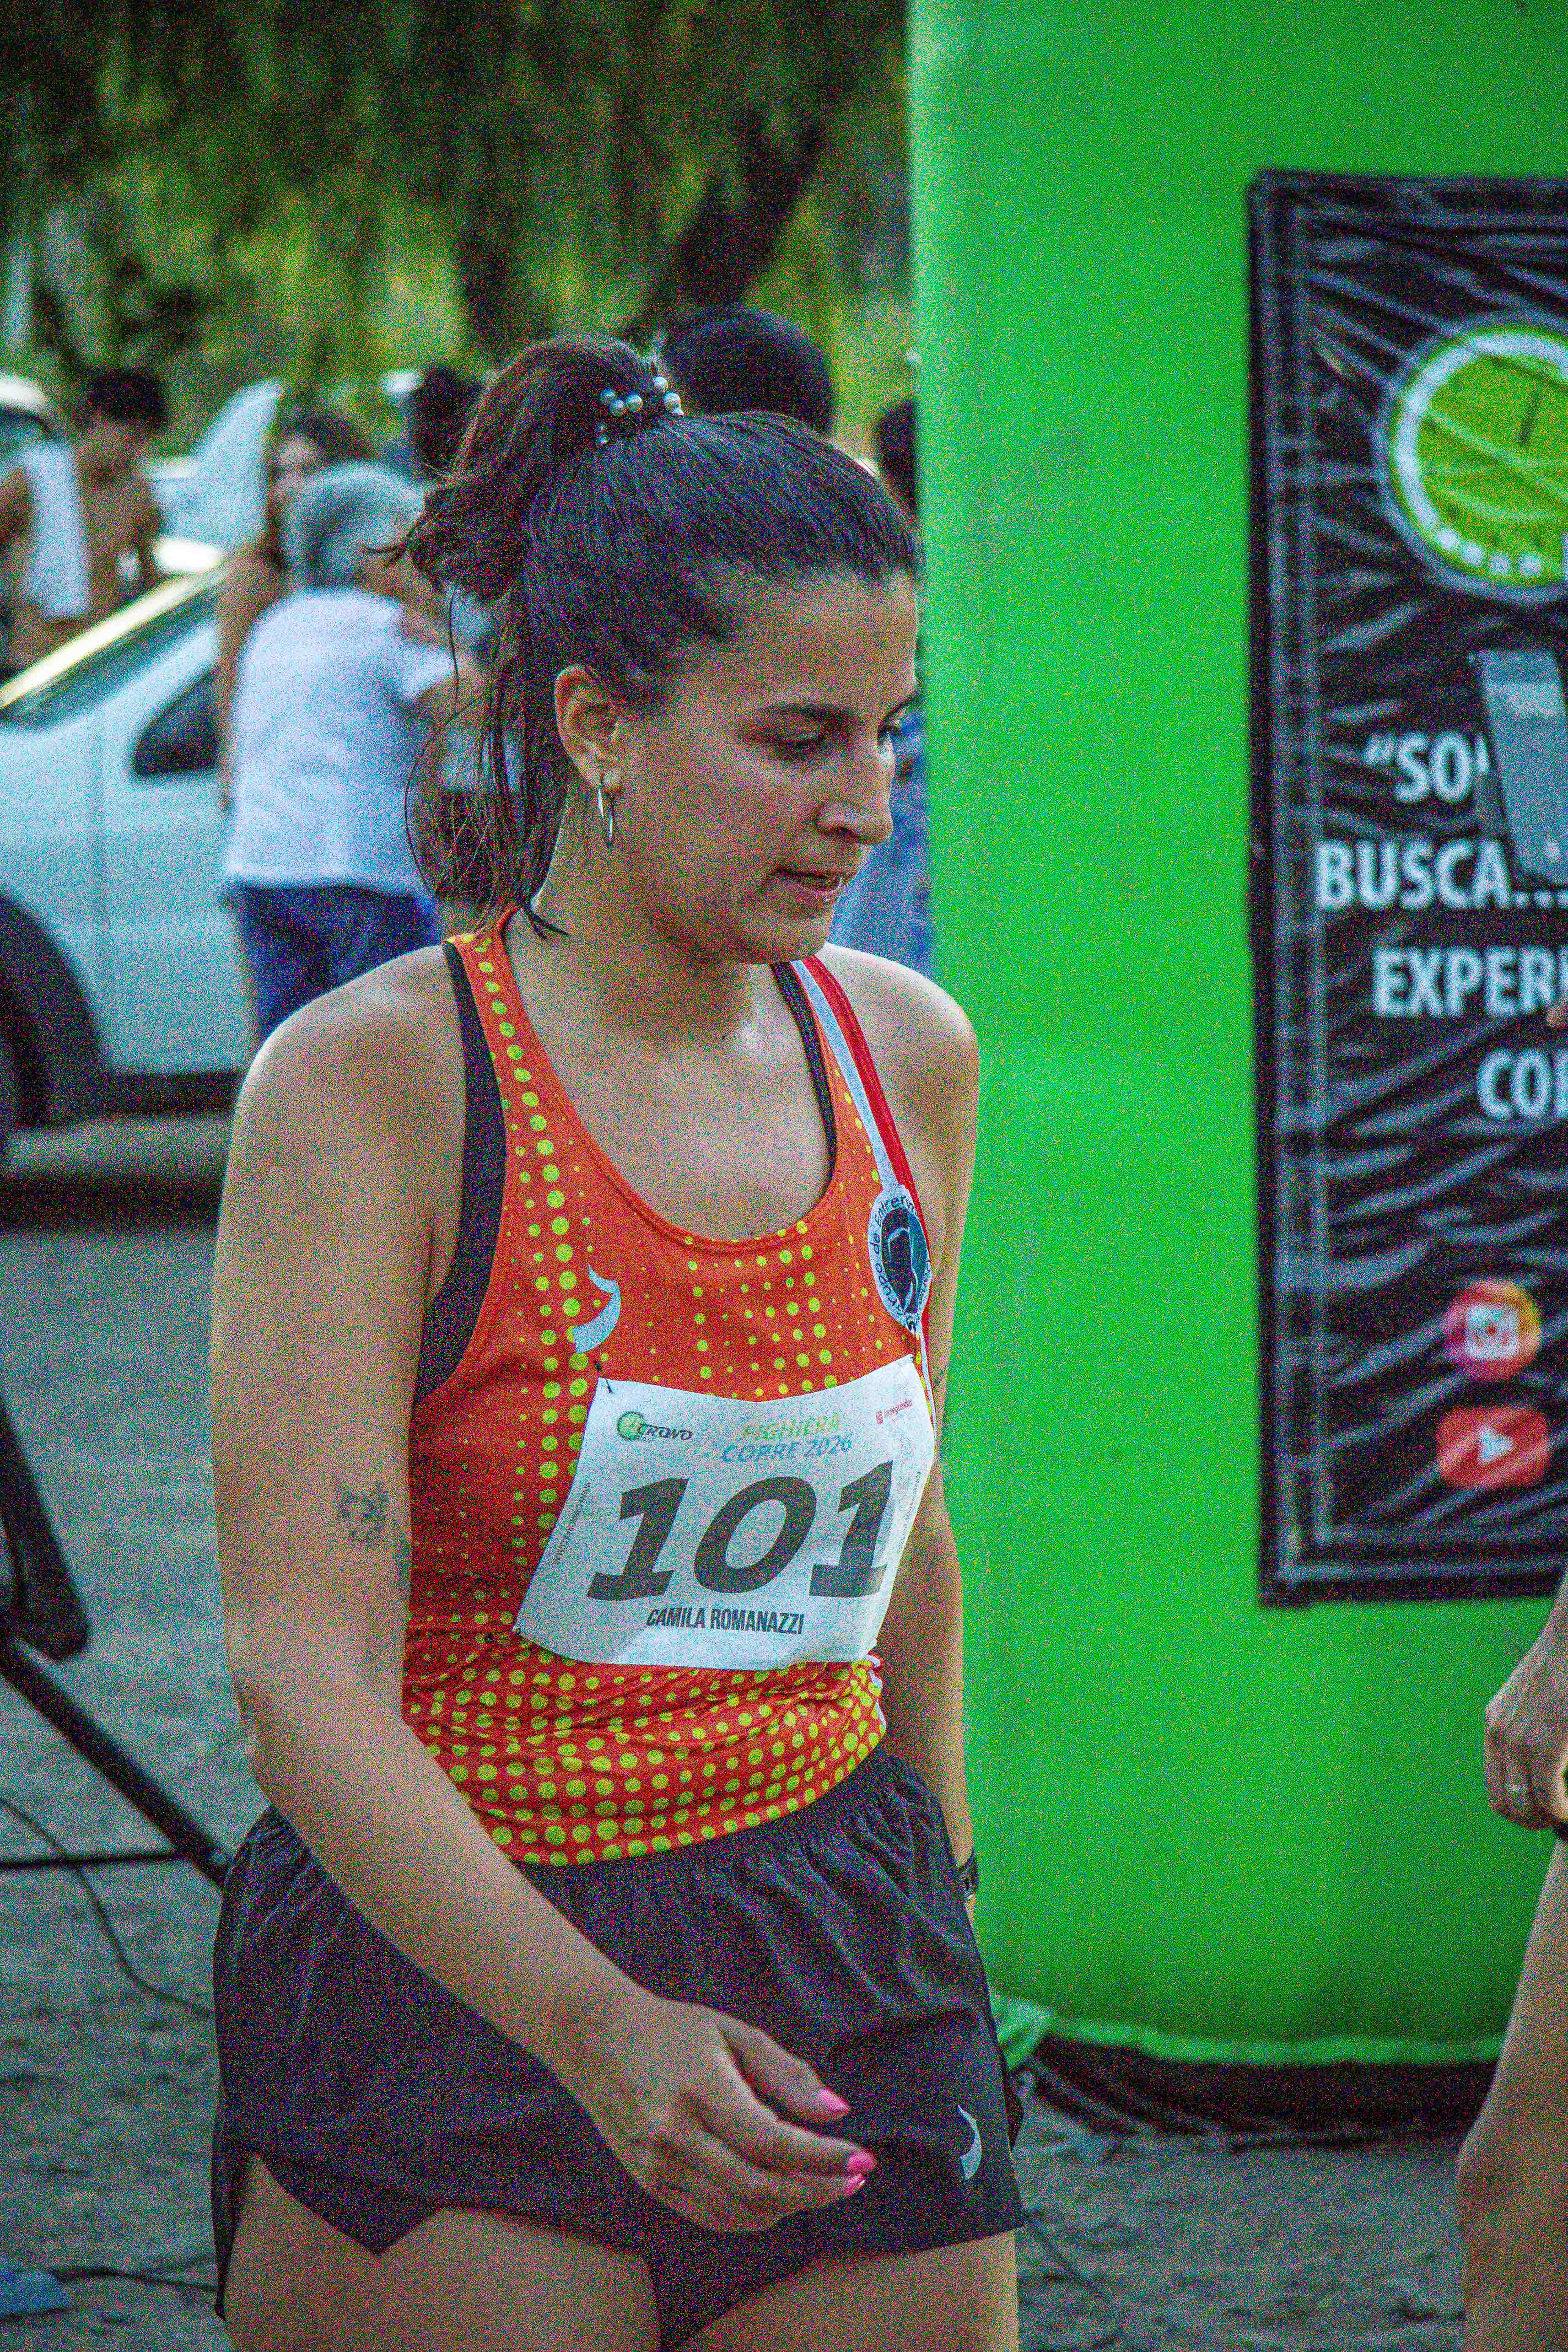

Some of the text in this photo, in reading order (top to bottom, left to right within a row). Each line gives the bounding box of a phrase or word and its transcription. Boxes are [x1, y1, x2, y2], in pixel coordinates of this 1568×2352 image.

[869, 1233, 881, 1254] de
[722, 1435, 852, 1463] CORRE 2026
[586, 1461, 893, 1601] 101
[646, 1608, 804, 1635] CAMILA ROMANAZZI
